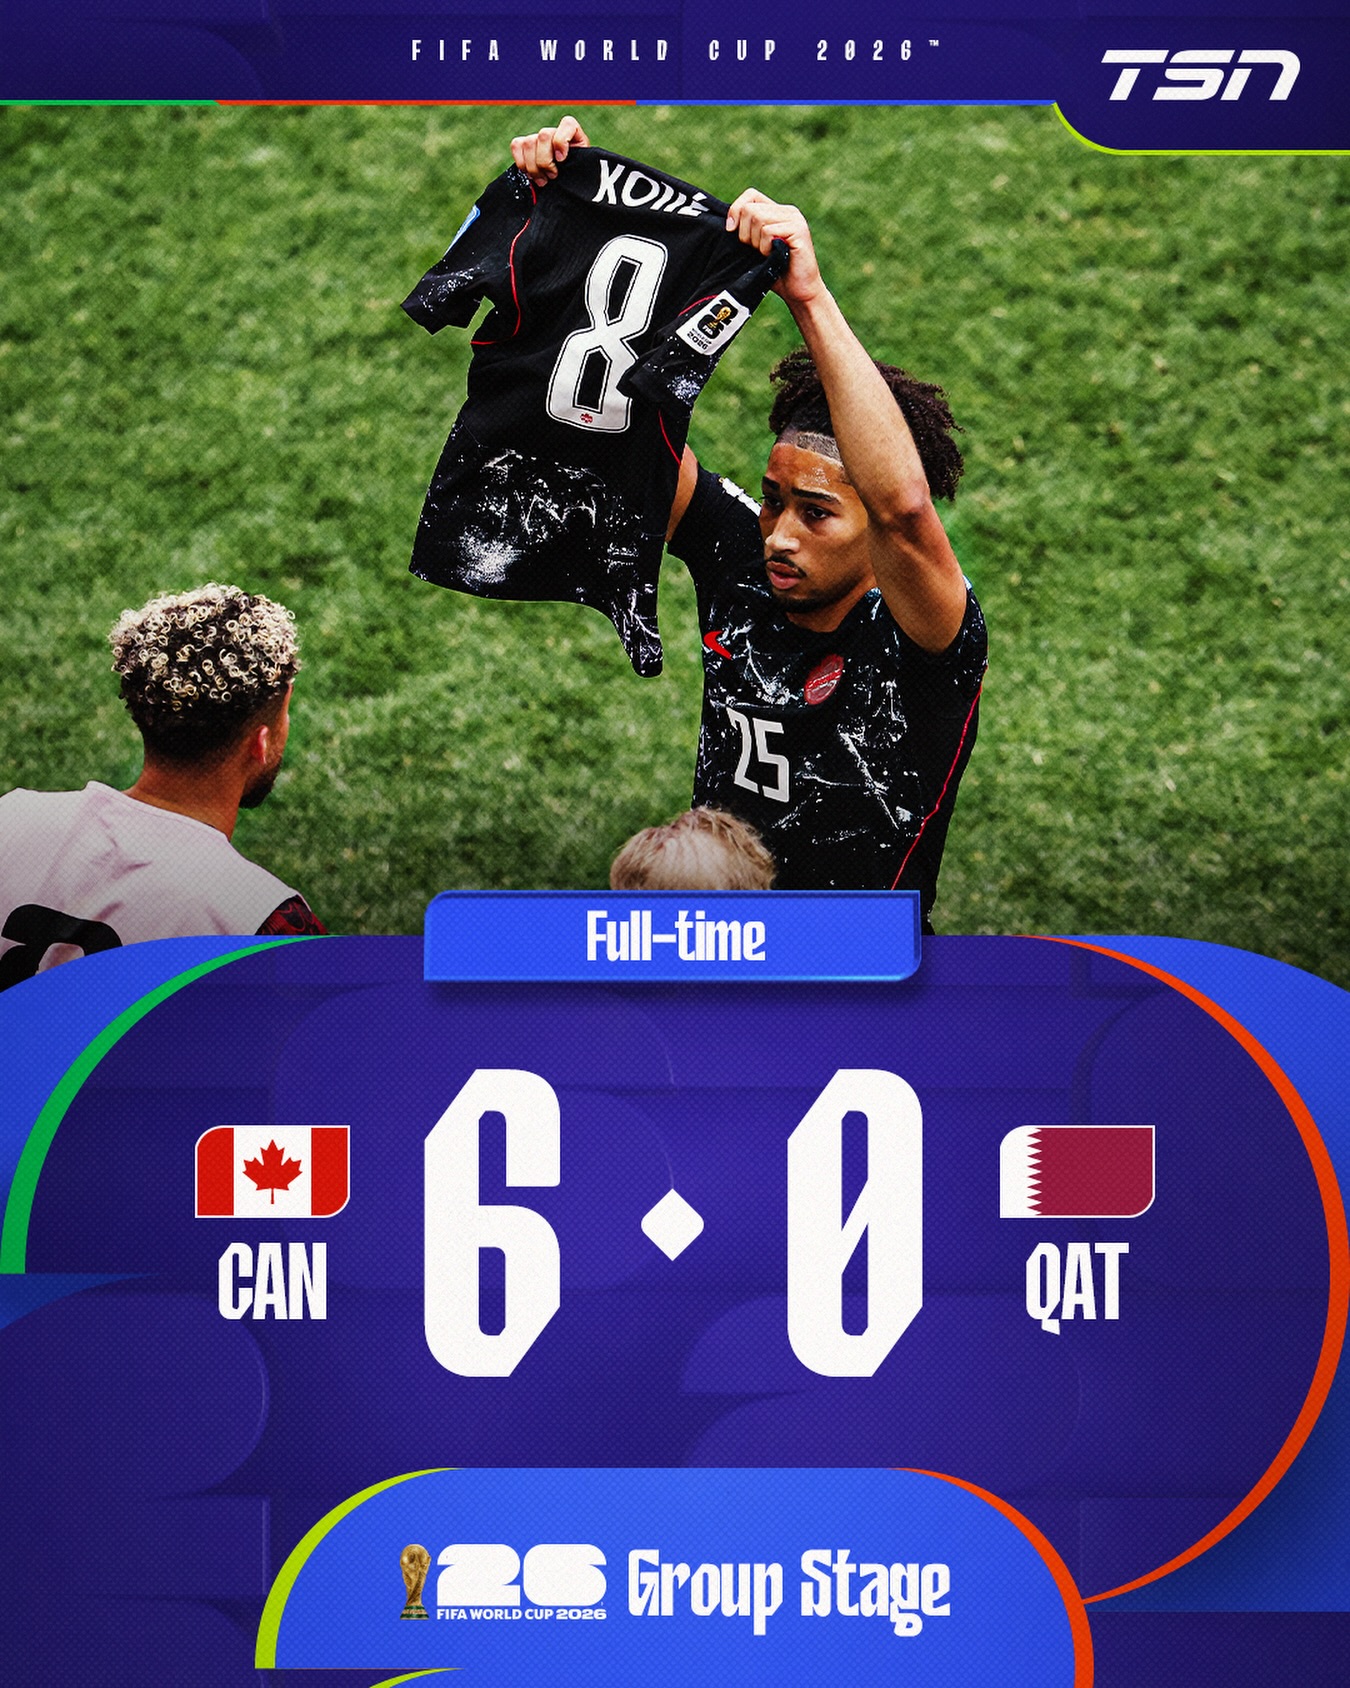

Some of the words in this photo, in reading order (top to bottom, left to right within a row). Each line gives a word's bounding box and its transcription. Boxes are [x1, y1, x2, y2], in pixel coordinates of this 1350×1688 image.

[546, 234, 669, 433] 8
[686, 330, 709, 350] 2026
[726, 706, 790, 803] 25
